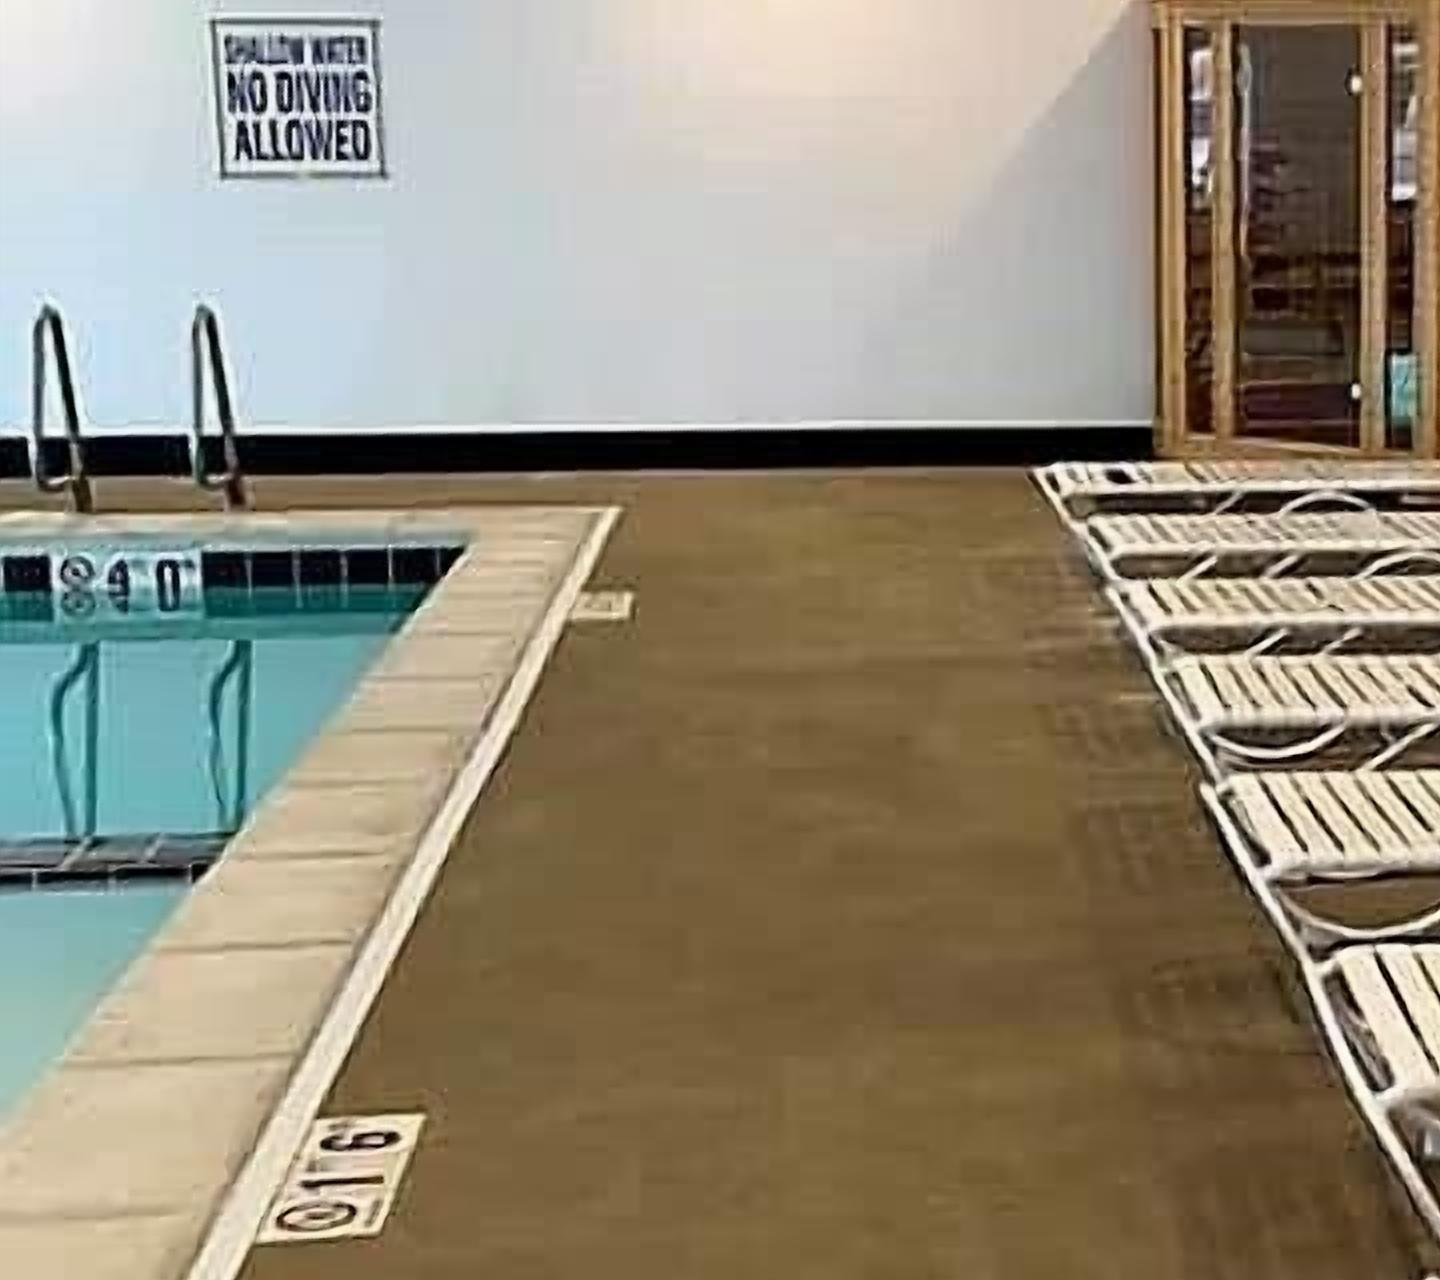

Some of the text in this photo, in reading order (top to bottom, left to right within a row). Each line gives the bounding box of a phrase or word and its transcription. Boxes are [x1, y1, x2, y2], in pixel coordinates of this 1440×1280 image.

[312, 35, 367, 65] WATER
[226, 69, 373, 114] NO DIVING
[234, 119, 373, 161] ALLOWED
